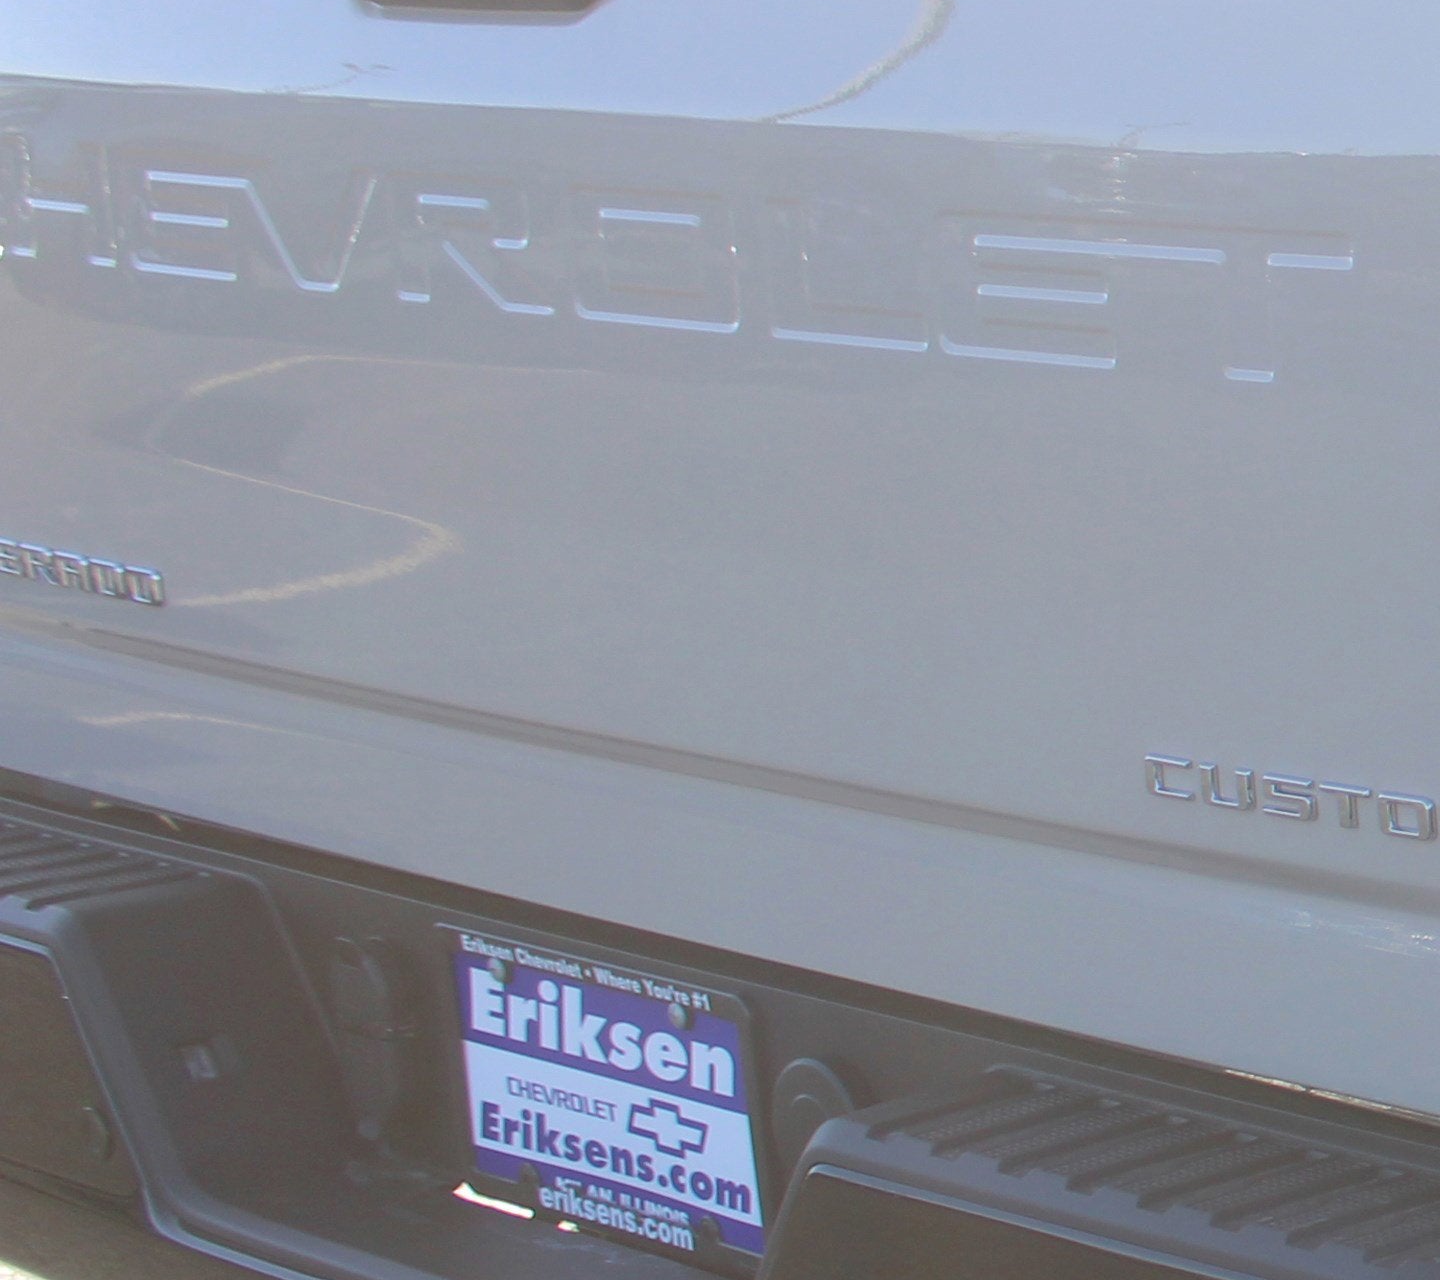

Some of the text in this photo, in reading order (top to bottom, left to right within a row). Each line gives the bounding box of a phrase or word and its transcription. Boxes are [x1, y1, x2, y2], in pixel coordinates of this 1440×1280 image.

[0, 134, 1355, 384] HEVROLET
[460, 933, 712, 1011] Eriksen Chevrolet Where You're #1
[469, 966, 736, 1099] Eriksen
[506, 1076, 617, 1122] CHEVROLET
[480, 1100, 752, 1215] Eriksens.com
[539, 1186, 695, 1251] eriksens.com
